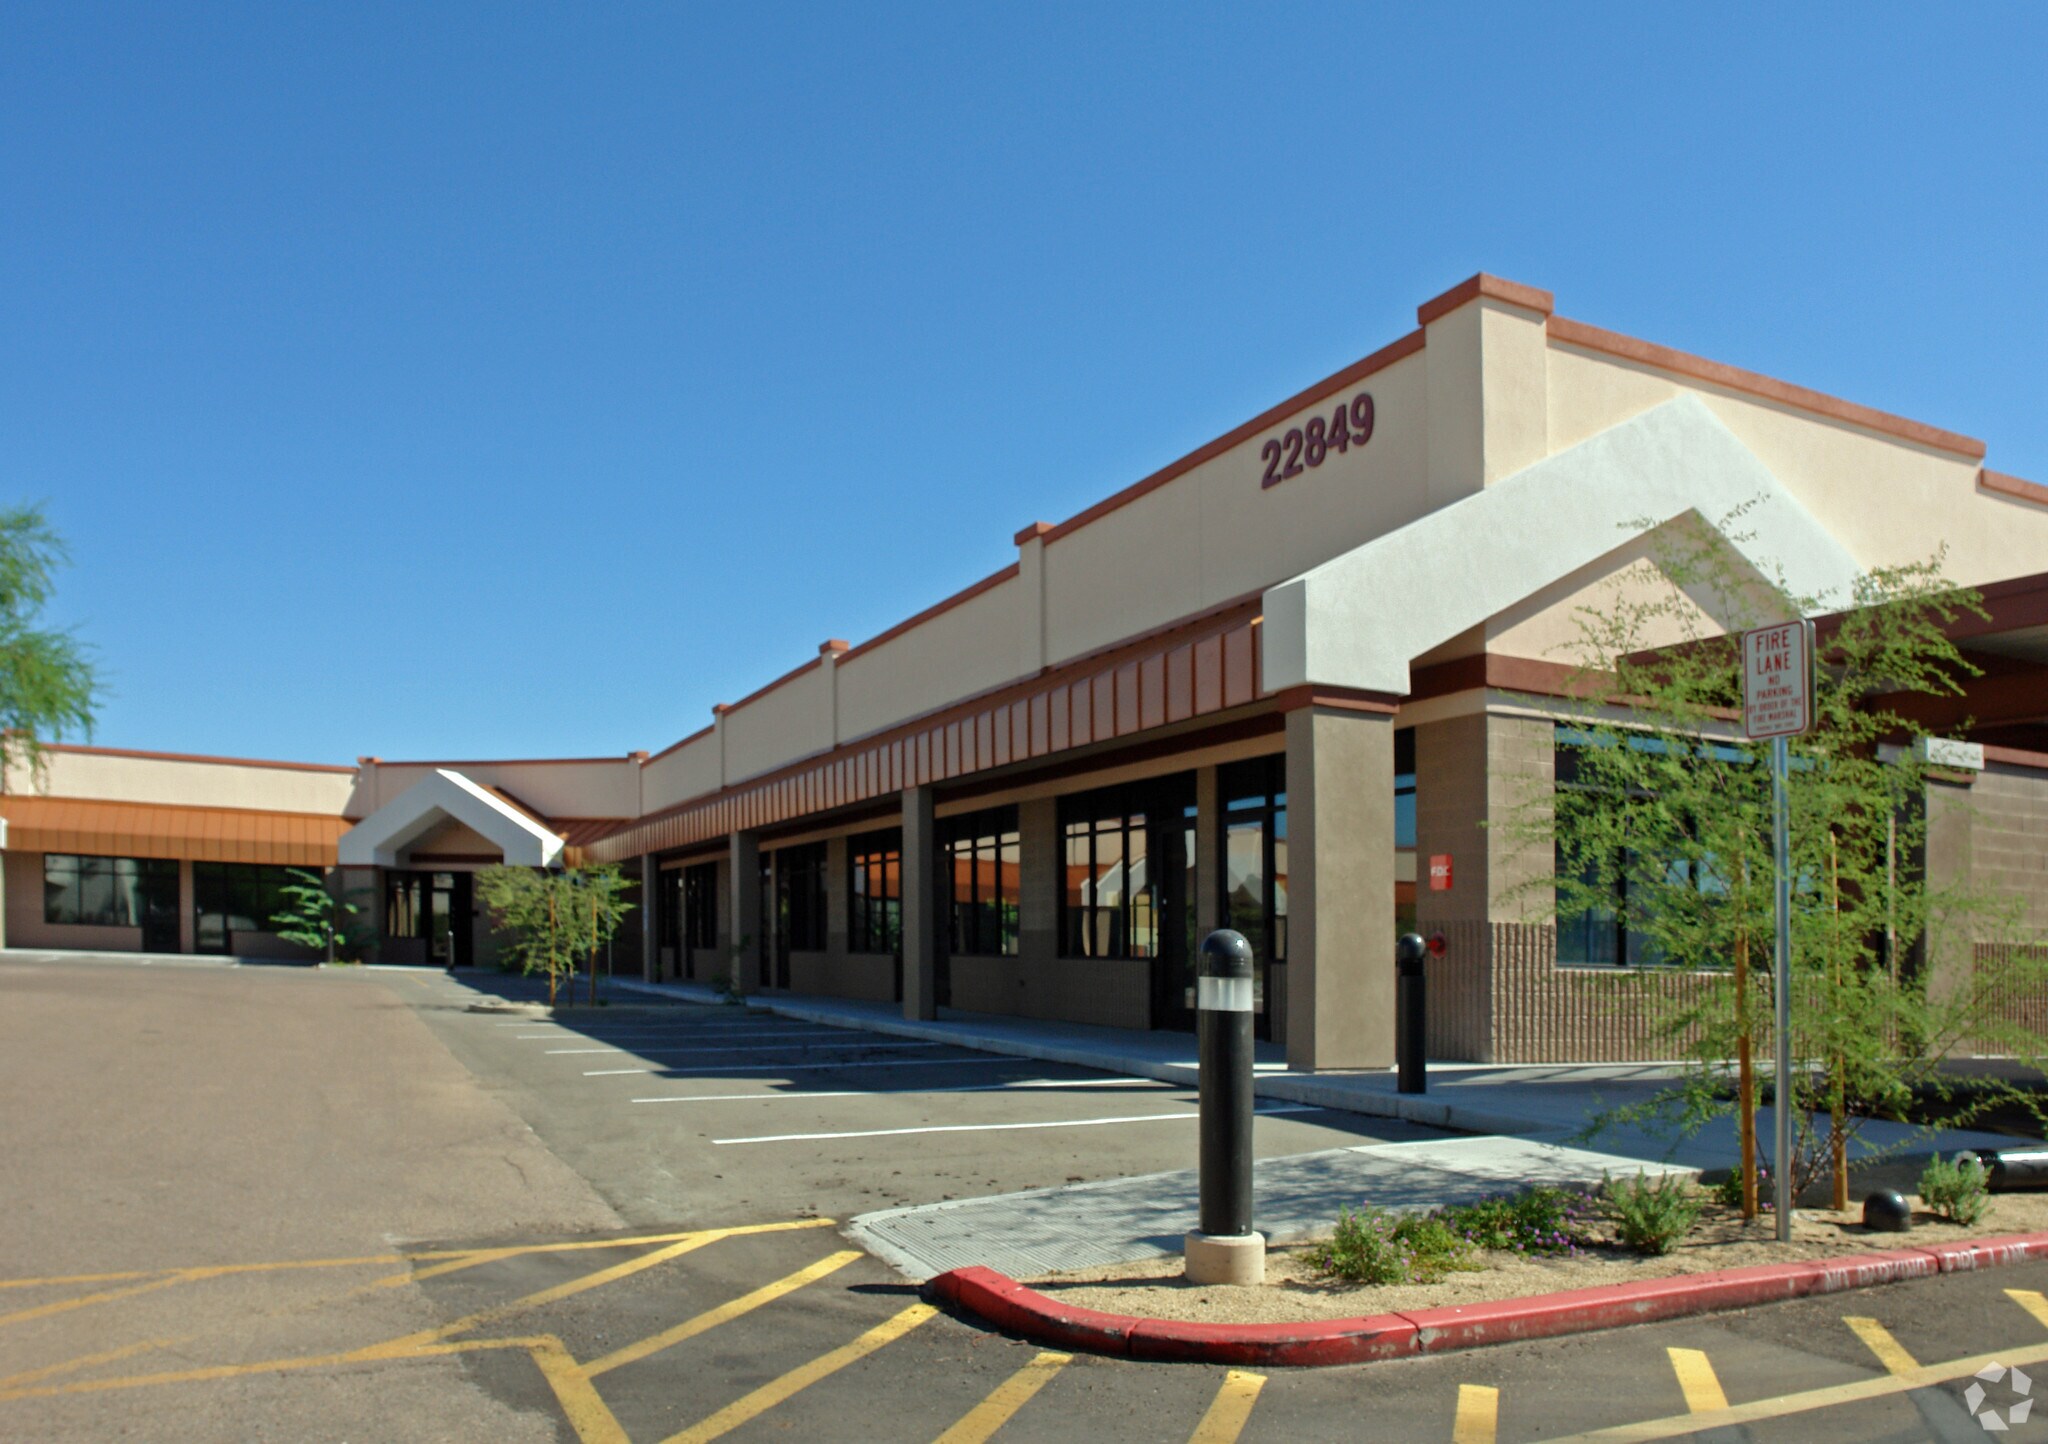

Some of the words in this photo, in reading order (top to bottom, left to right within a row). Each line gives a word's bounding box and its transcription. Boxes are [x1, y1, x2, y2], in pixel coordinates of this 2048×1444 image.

[1261, 392, 1375, 490] 22849
[1755, 629, 1790, 653] FIRE
[1757, 651, 1791, 675] LANE
[1767, 675, 1780, 685] NO
[1757, 685, 1793, 700] PARKING
